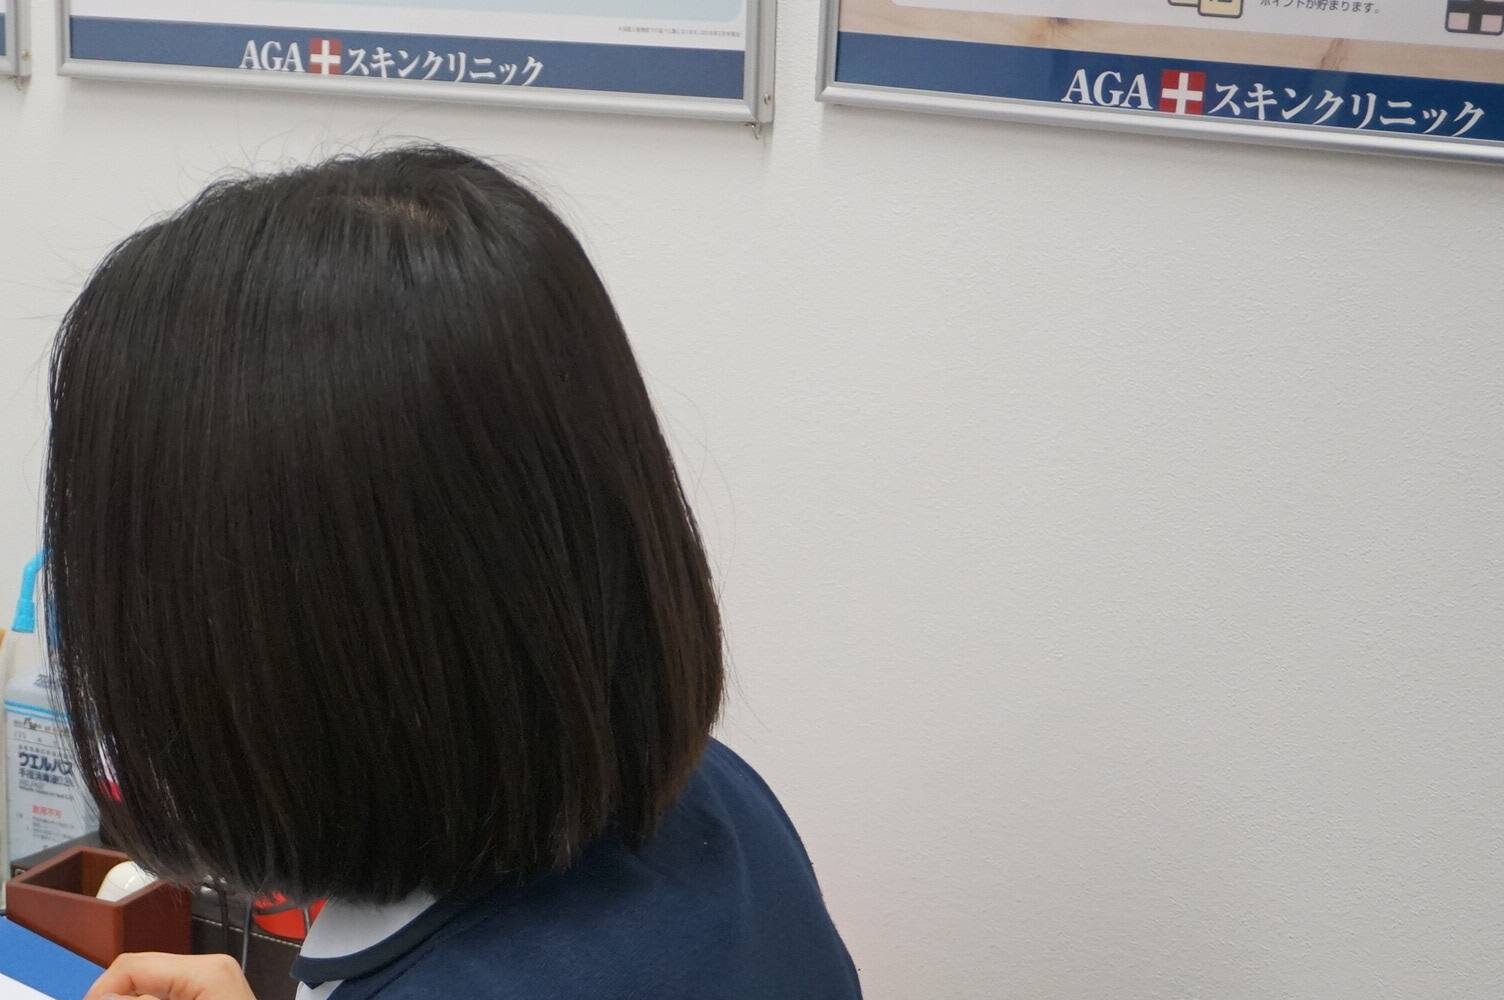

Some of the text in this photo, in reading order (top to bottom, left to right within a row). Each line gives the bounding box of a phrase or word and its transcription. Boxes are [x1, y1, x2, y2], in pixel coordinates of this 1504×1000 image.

[239, 40, 544, 86] AGA スキンクリニック
[1061, 68, 1485, 137] AGA スキンクリニック
